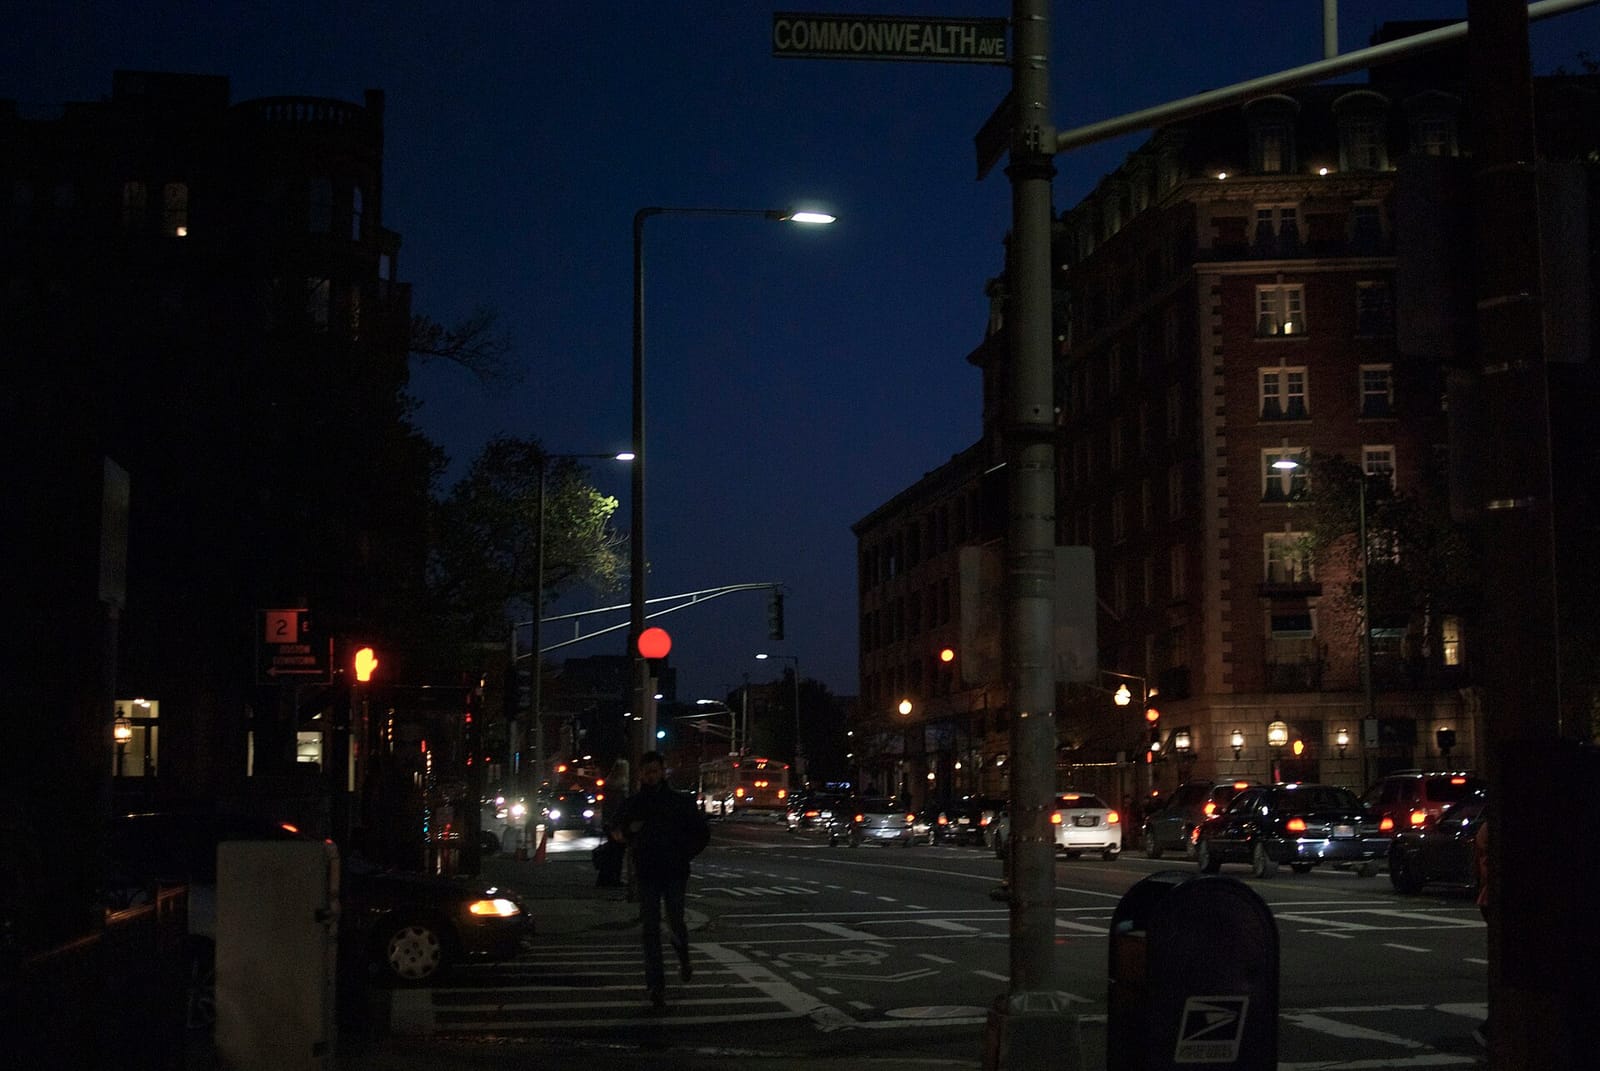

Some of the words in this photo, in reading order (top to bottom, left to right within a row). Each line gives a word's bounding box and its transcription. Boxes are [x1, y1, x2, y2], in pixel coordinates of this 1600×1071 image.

[774, 19, 977, 55] COMMONWEALTH
[978, 37, 1005, 56] AVE
[277, 619, 287, 635] 2
